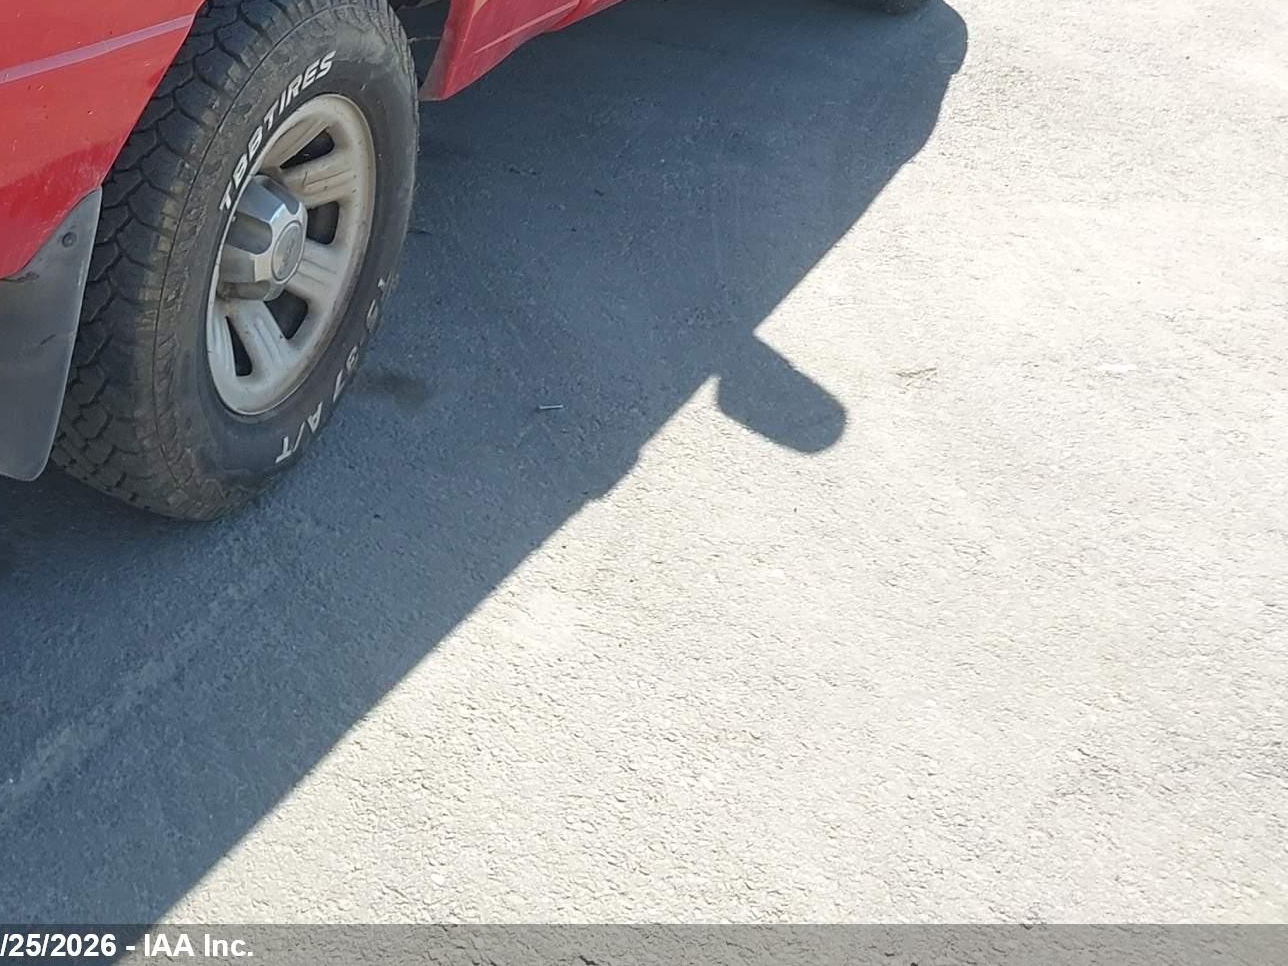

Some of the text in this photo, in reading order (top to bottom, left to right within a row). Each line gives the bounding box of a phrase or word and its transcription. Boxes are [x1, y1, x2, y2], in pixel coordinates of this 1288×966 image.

[219, 50, 337, 211] TBB TIRES
[275, 401, 324, 464] A/T
